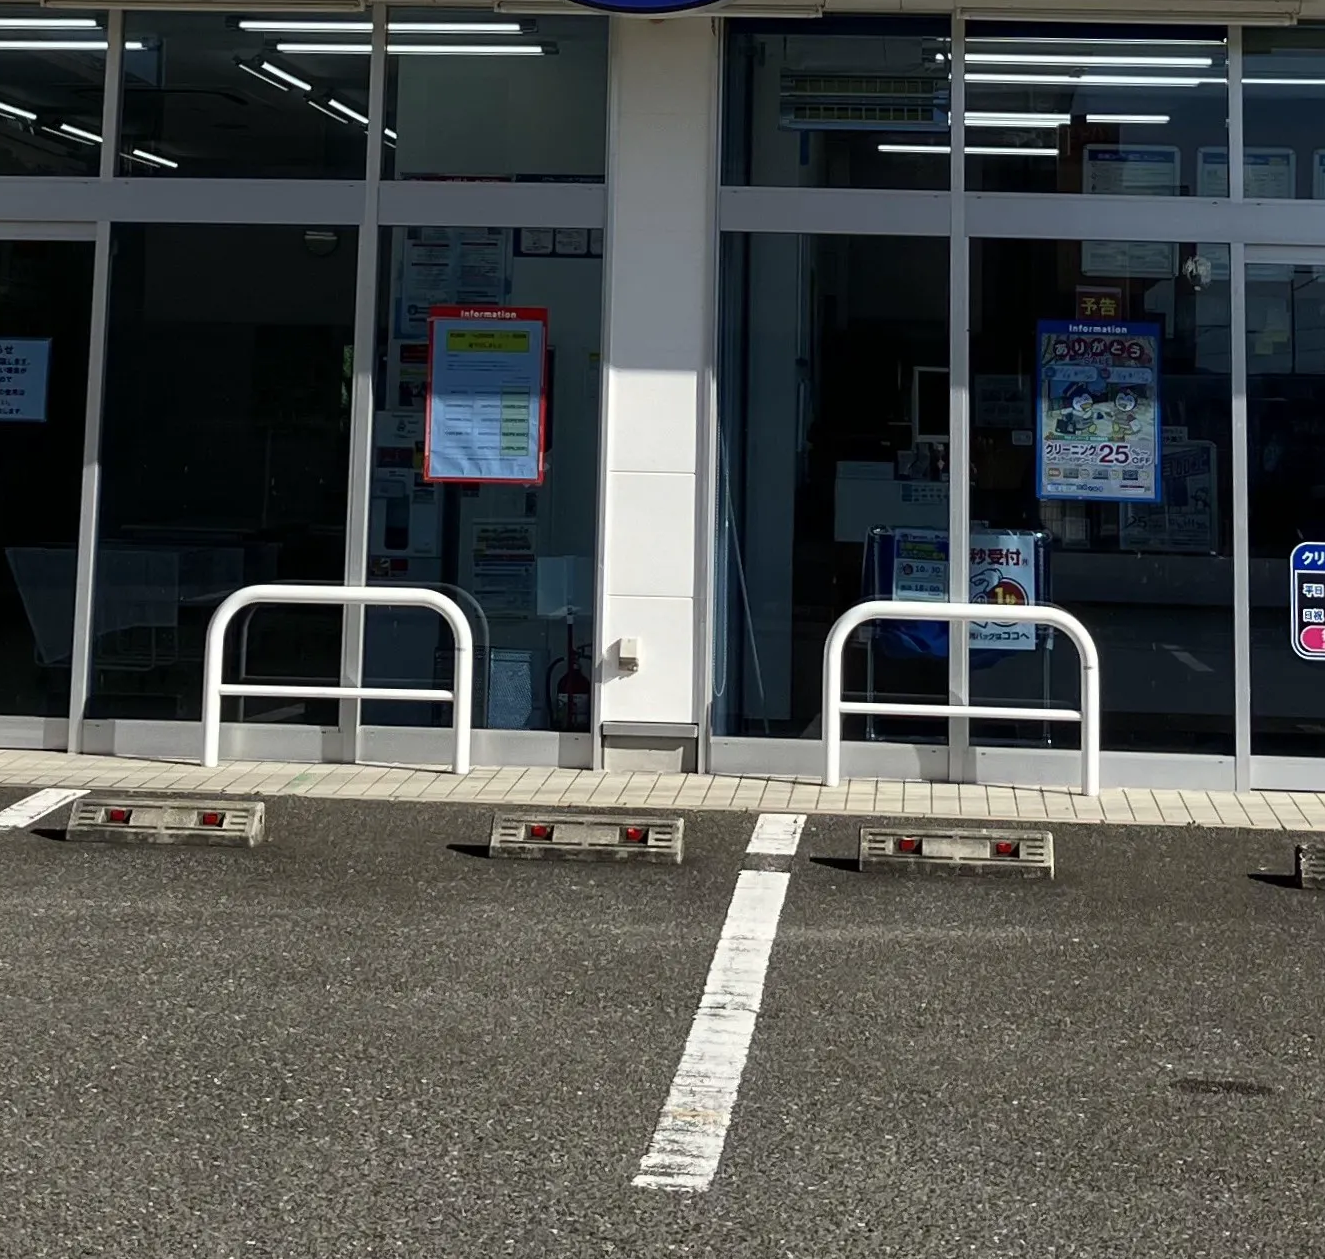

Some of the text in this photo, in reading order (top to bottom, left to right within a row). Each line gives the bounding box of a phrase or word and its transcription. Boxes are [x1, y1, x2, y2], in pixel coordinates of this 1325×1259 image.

[460, 309, 517, 319] Information
[1080, 297, 1117, 316] 予告
[1068, 324, 1128, 334] Information
[1055, 339, 1142, 358] ありがとう
[1098, 443, 1130, 464] 25
[1303, 583, 1325, 598] 平日
[1303, 608, 1325, 623] 日祝
